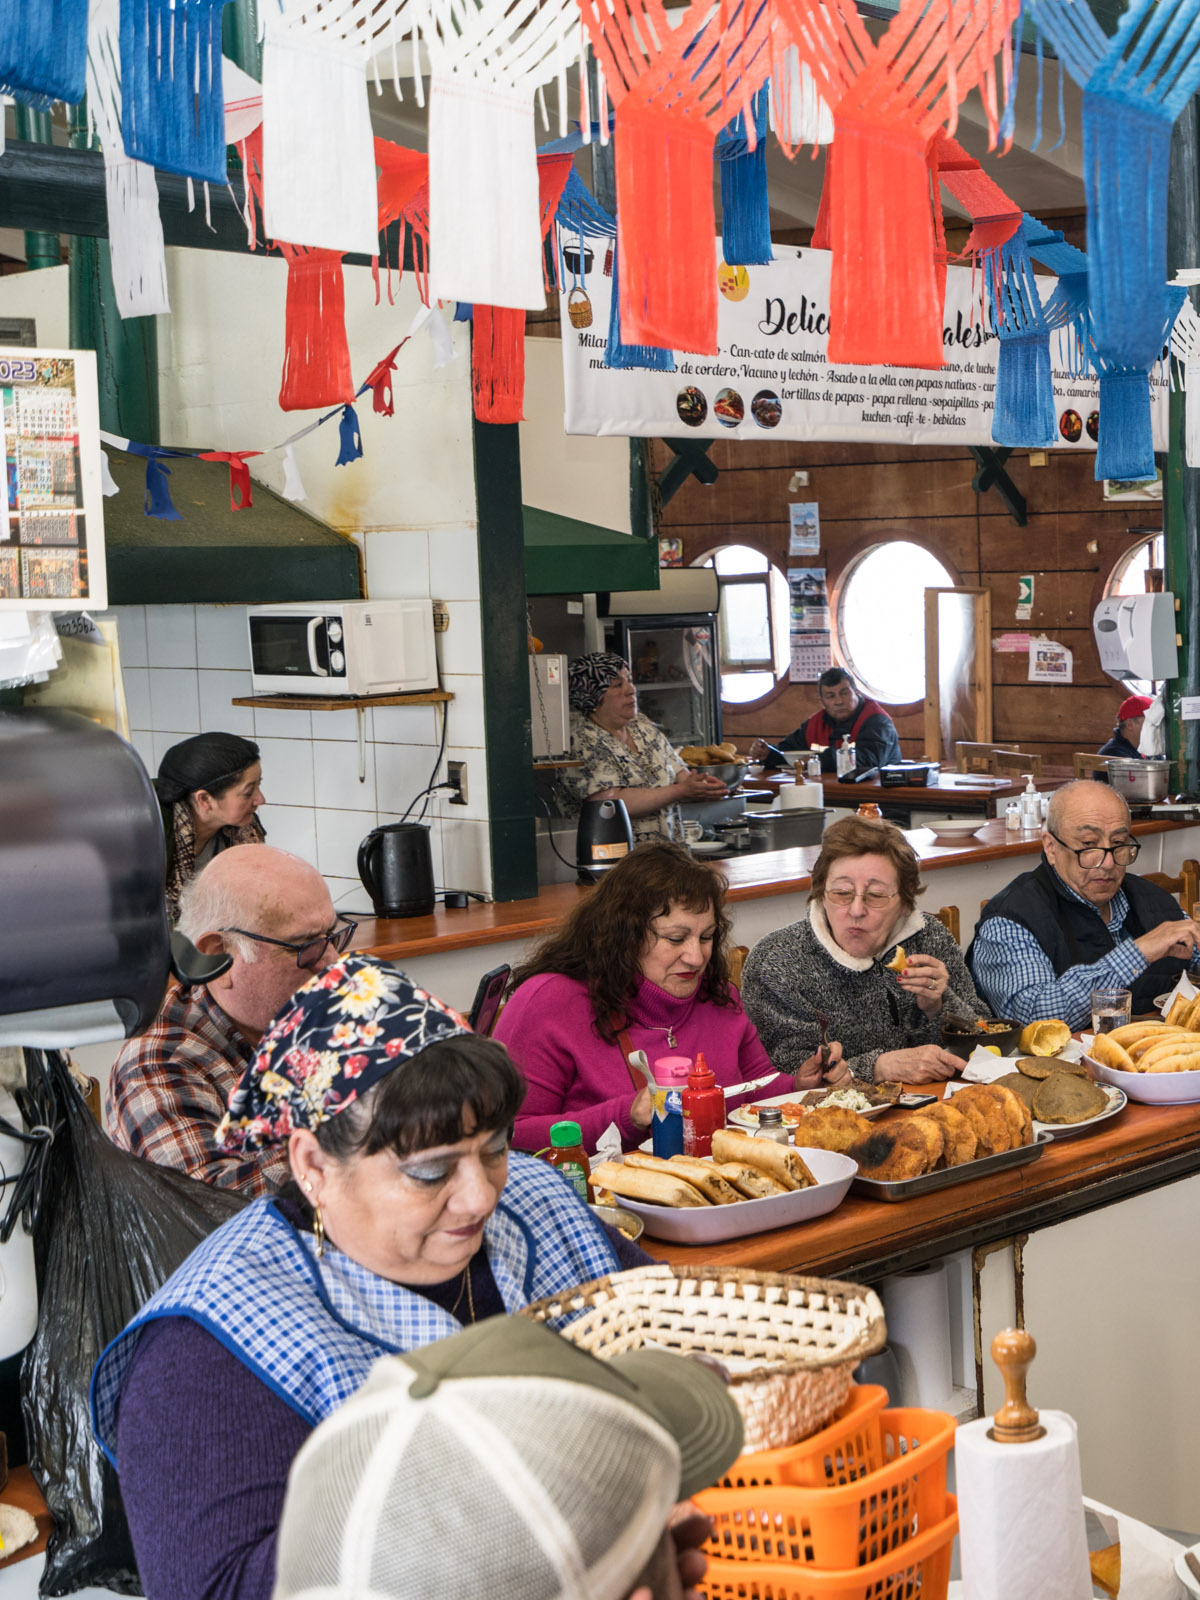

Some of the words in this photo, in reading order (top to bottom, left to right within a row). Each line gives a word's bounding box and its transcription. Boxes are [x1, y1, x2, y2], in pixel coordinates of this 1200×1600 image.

[943, 310, 984, 348] ales
[0, 360, 36, 380] 023
[780, 348, 789, 361] de
[790, 348, 827, 363] salmón
[964, 361, 975, 373] de
[680, 361, 693, 375] de
[780, 370, 786, 384] y
[788, 368, 818, 382] lechón
[826, 369, 858, 384] Asado
[859, 375, 866, 385] a
[868, 373, 878, 385] la
[879, 373, 898, 386] olla
[898, 378, 914, 388] con
[915, 379, 943, 392] papas
[944, 379, 977, 391] nativas
[781, 388, 821, 401] tortillas
[822, 389, 834, 402] de
[835, 393, 864, 406] papas
[872, 394, 895, 408] papa
[897, 394, 927, 406] rellena
[861, 410, 891, 423] kuchen
[932, 413, 967, 426] bebidas
